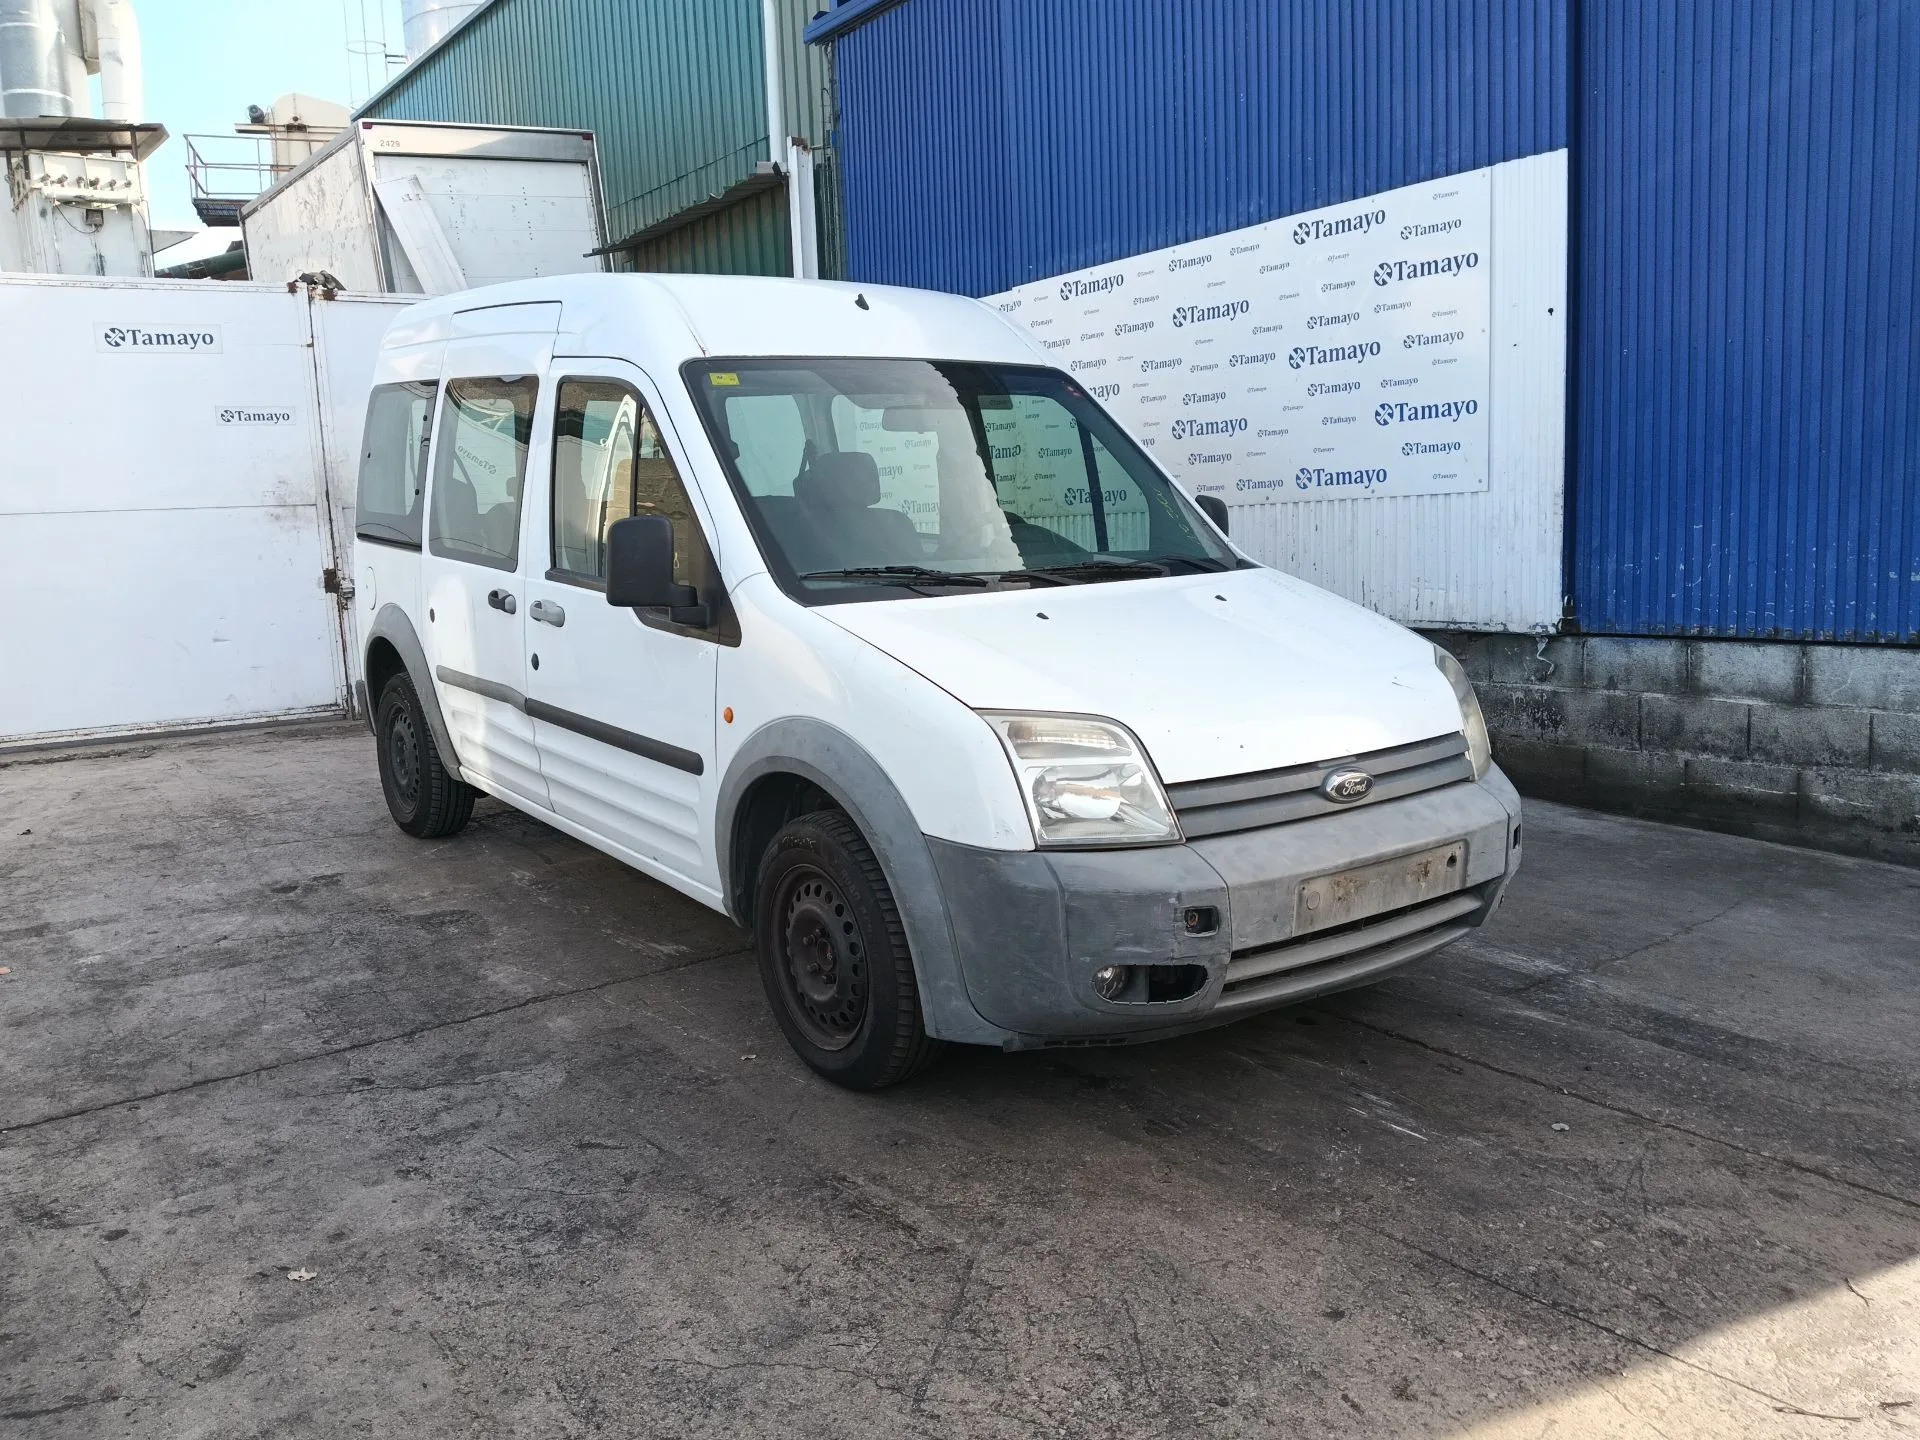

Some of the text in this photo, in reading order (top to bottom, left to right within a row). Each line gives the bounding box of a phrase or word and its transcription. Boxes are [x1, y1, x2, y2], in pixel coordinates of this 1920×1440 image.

[1312, 209, 1385, 240] Tamayo
[1413, 219, 1461, 237] Tamayo
[1236, 243, 1259, 254] Tamayo
[1177, 254, 1212, 271] Tamayo
[1265, 261, 1289, 272] Tamayo
[1394, 252, 1478, 281] Tamayo
[1073, 274, 1124, 297] Tamayo
[1328, 280, 1355, 291] Tamayo
[1139, 295, 1159, 304] Tamayo
[1188, 300, 1249, 324] Tamayo
[1382, 301, 1411, 312] Tamayo
[1318, 312, 1359, 328] Tamayo
[1123, 320, 1154, 334] Tamayo
[1259, 324, 1282, 334] Tamayo
[126, 329, 214, 349] Tamayo
[1086, 331, 1104, 340] Tamayo
[1415, 330, 1464, 346] Tamayo
[1238, 352, 1275, 366] Tamayo
[1306, 341, 1381, 365] Tamayo
[1078, 359, 1106, 369] Tamayo
[1149, 357, 1182, 370] Tamayo
[1196, 363, 1218, 371] Tamayo
[1318, 381, 1360, 395] Tamayo
[1388, 377, 1418, 387] Tamayo
[1146, 394, 1166, 403] Tamayo
[1192, 391, 1226, 404] Tamayo
[235, 410, 290, 424] Tamayo
[1395, 399, 1478, 422] Tamayo
[992, 422, 1016, 430] Tamayo
[1187, 417, 1247, 437] Tamayo
[1329, 416, 1356, 425] Tamayo
[1264, 428, 1288, 438] Tamayo
[1046, 448, 1072, 457] Tamayo
[1413, 441, 1460, 455] Tamayo
[1197, 453, 1231, 464] Tamayo
[1246, 479, 1283, 490] Tamayo
[1313, 468, 1387, 489] Tamayo
[1203, 484, 1224, 492] Tamayo
[1343, 778, 1366, 795] Ford
